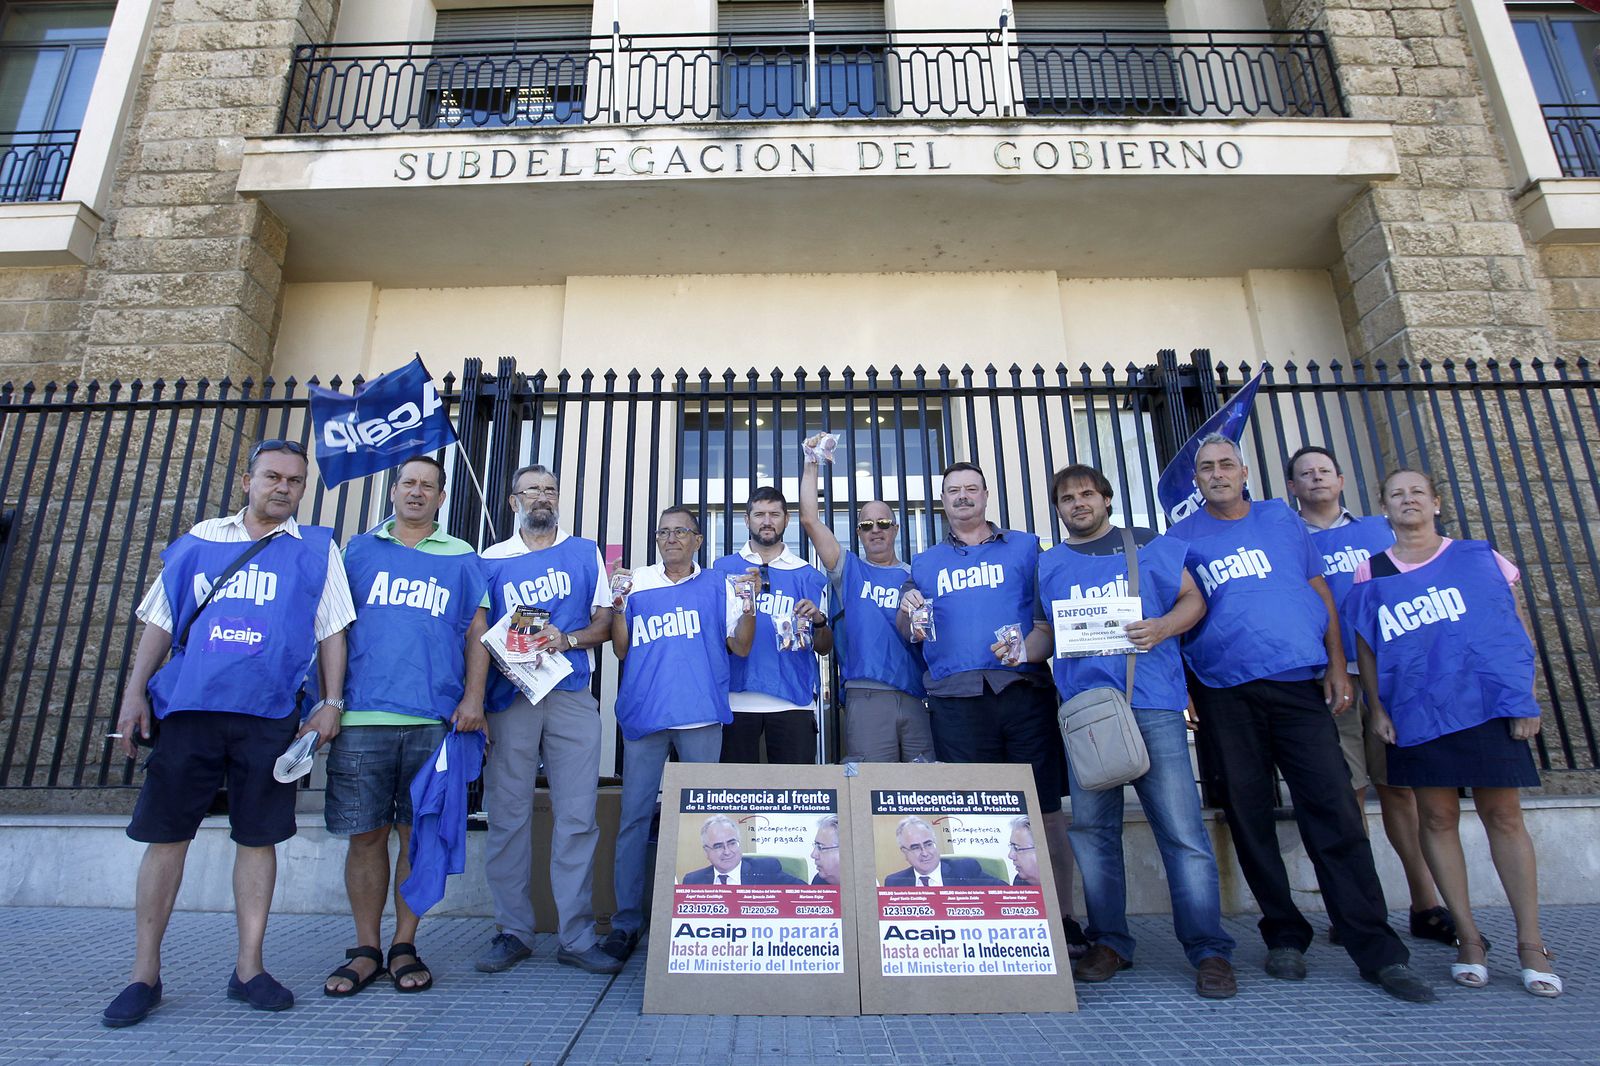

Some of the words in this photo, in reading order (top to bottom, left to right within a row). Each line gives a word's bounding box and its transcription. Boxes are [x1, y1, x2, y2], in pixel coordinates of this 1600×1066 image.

[394, 141, 815, 181] SUBDELEGACION
[858, 141, 951, 170] DEL
[994, 139, 1244, 171] GOBIERNO
[937, 561, 1005, 597] Acaip
[1196, 546, 1273, 597] Acaip
[366, 571, 450, 617] Acaip
[503, 567, 571, 613] Acaip
[860, 580, 901, 609] Aca
[1058, 607, 1107, 617] ENFOQUE
[1378, 586, 1467, 642] Acaip
[209, 625, 263, 646] Acaip
[632, 606, 701, 647] Acaip
[690, 790, 704, 803] La
[707, 790, 774, 804] indecencia
[777, 790, 788, 803] al
[792, 790, 829, 803] frente
[880, 792, 894, 804] La
[898, 792, 963, 805] indecencia
[967, 792, 978, 804] al
[981, 793, 1018, 805] frente
[675, 923, 746, 942] Acaip
[752, 926, 773, 938] no
[780, 923, 838, 941] parará
[884, 926, 956, 944] Acaip
[961, 928, 982, 940] no
[989, 924, 1046, 944] parará
[672, 942, 708, 956] hasta
[712, 942, 748, 956] echar
[752, 942, 764, 956] la
[768, 942, 839, 956] Indecencia
[883, 945, 919, 958] hasta
[923, 944, 959, 958] echar
[964, 944, 975, 958] la
[979, 943, 1050, 958] Indecencia
[670, 959, 689, 971] del
[694, 959, 761, 971] Ministerio
[766, 959, 786, 971] del
[790, 959, 840, 971] Interior
[884, 962, 903, 973] del
[908, 962, 974, 973] Ministerio
[979, 962, 998, 973] del
[1003, 961, 1052, 972] Interior
